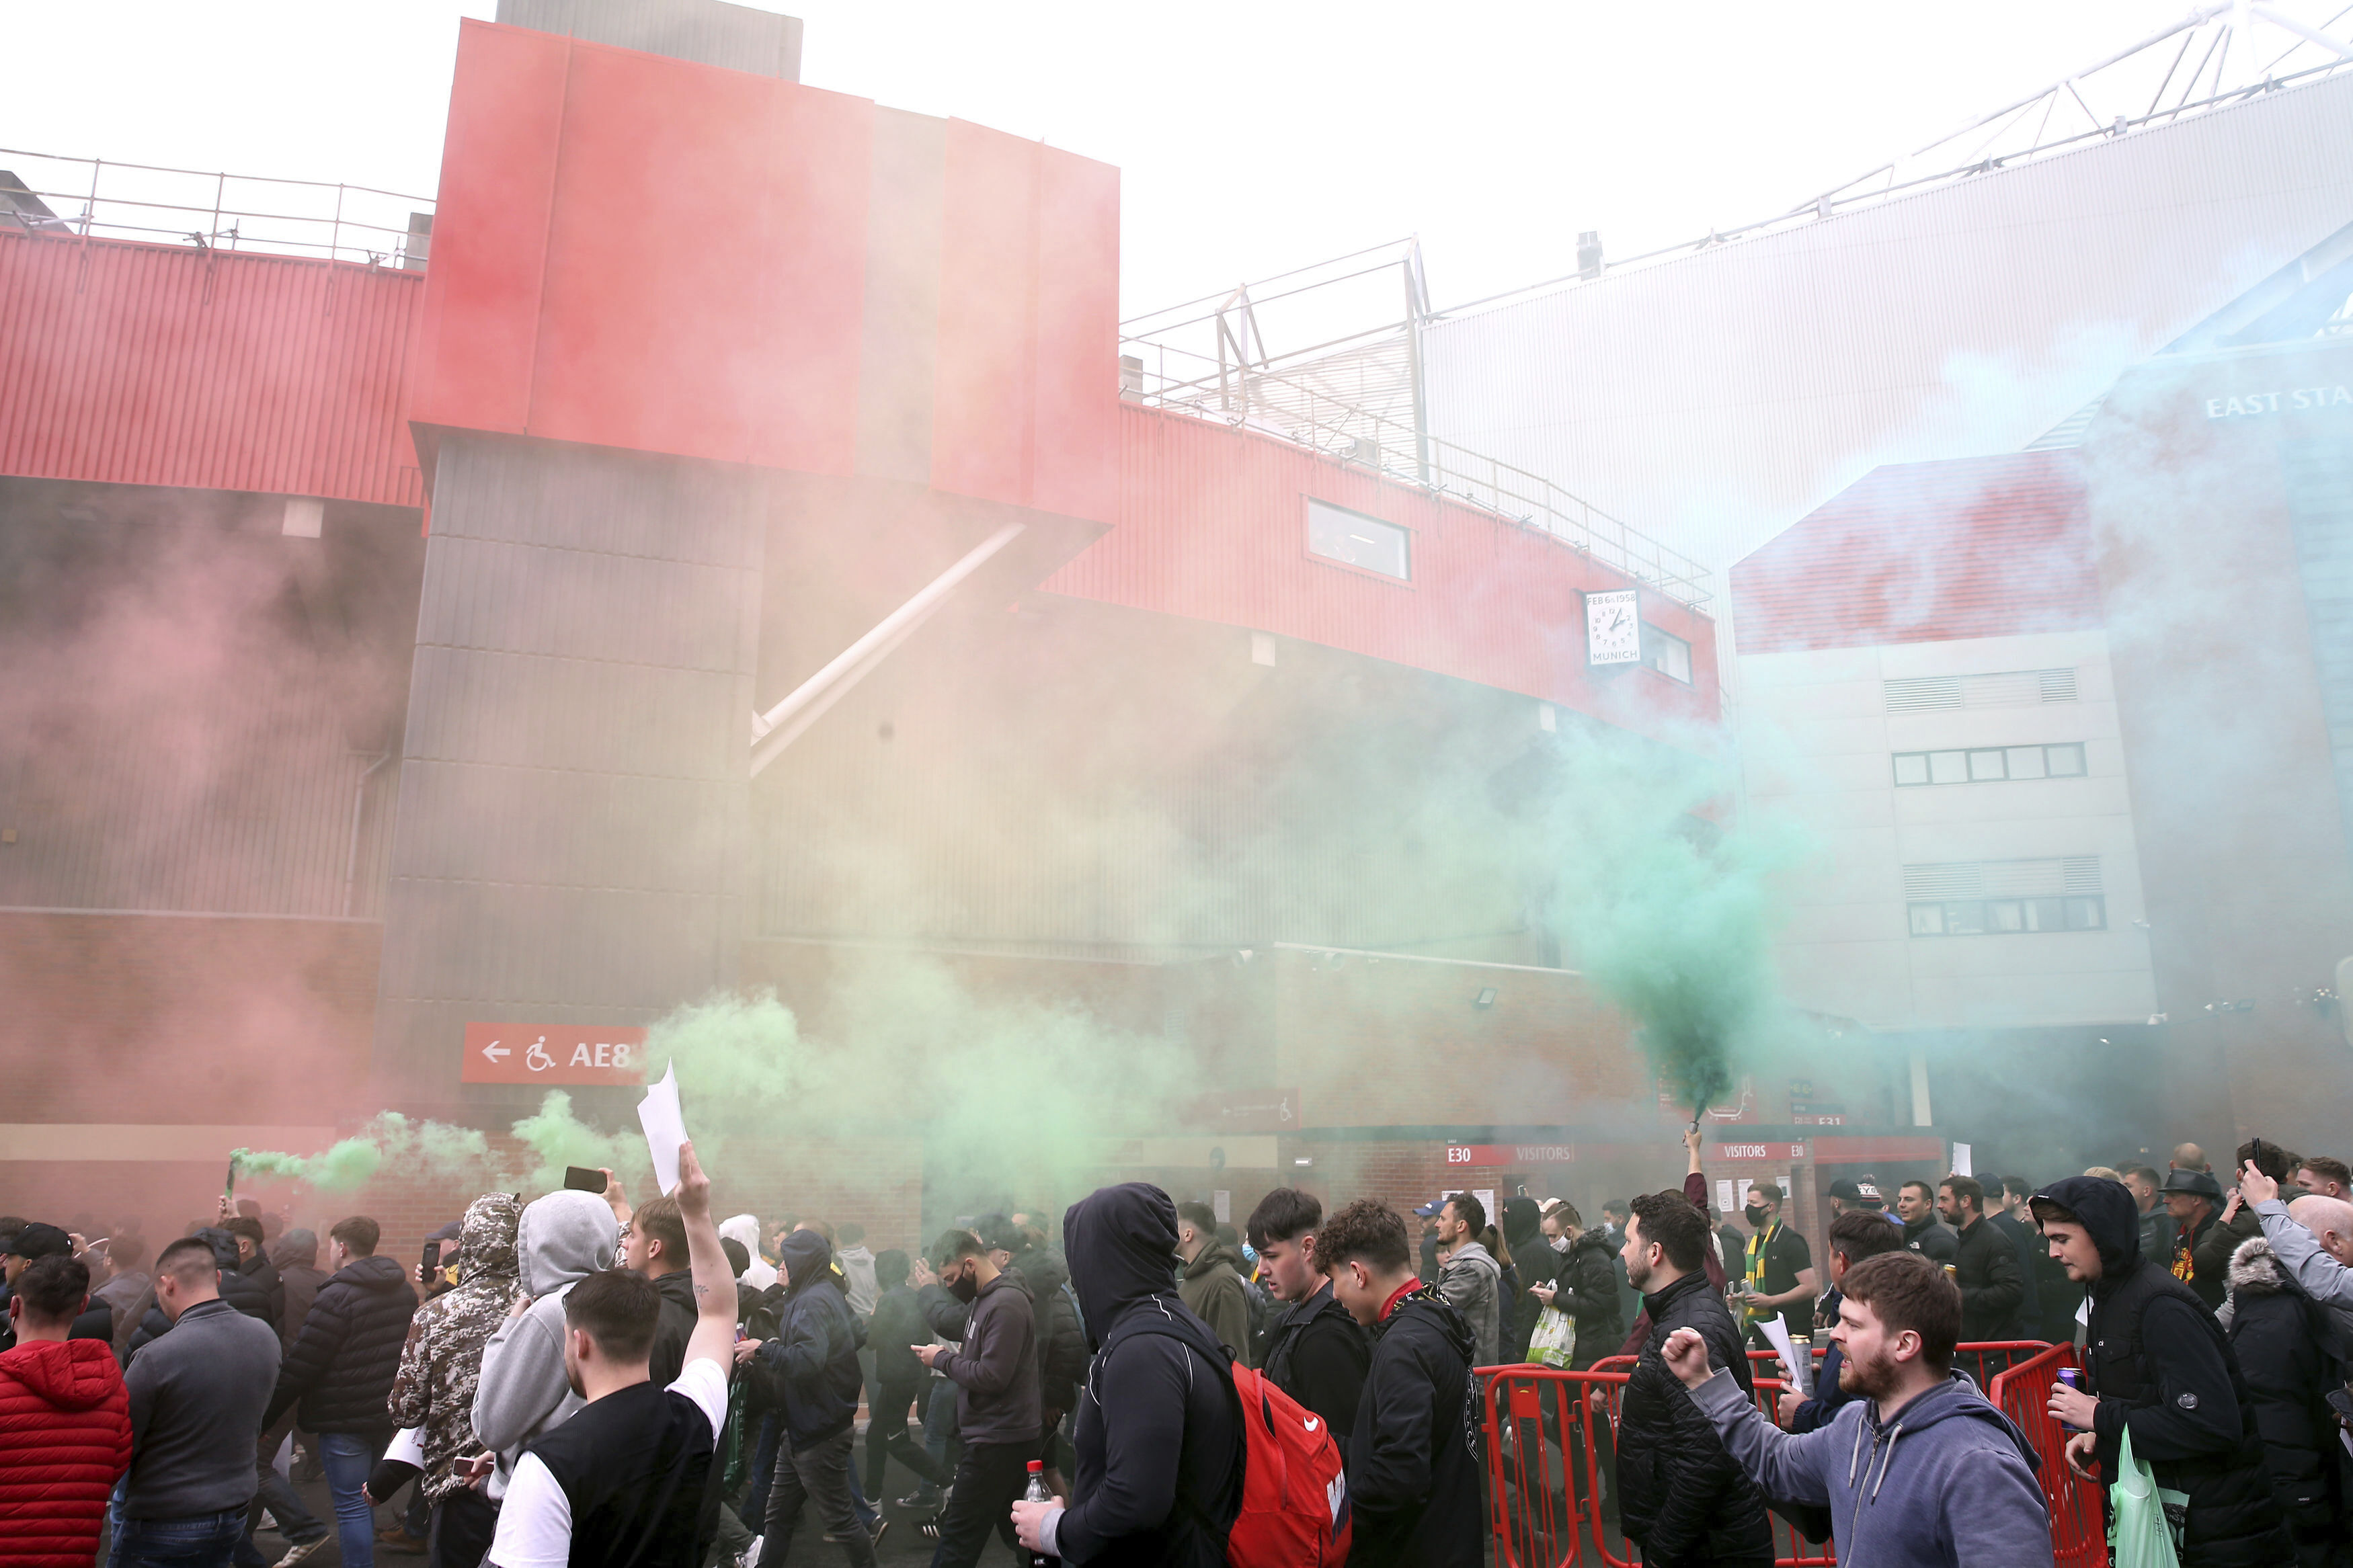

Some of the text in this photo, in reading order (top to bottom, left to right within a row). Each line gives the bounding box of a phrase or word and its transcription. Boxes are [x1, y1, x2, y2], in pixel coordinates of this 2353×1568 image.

[2206, 393, 2281, 418] EAST
[1587, 597, 1603, 605] FEB
[1617, 594, 1636, 603] 1958
[1593, 650, 1637, 661] MUNICH
[569, 1043, 631, 1068] AE8
[1447, 1147, 1570, 1163] E30 VISITORS
[1724, 1145, 1803, 1158] VISITORS E30
